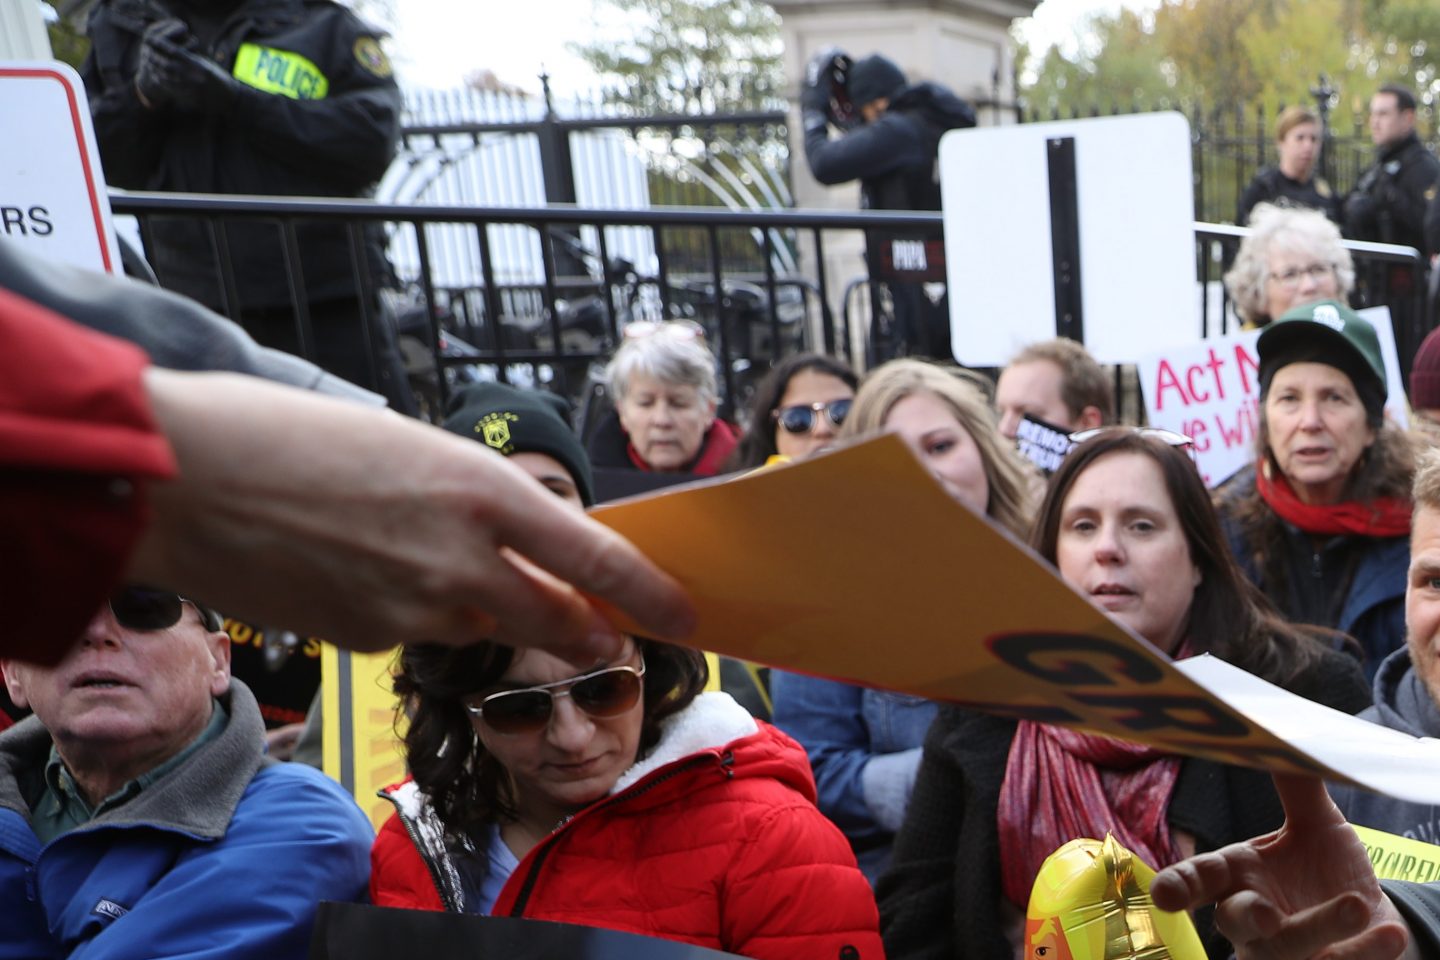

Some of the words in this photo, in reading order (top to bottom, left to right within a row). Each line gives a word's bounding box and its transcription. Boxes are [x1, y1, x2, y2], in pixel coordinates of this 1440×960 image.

[253, 49, 323, 100] POLICE
[1, 206, 53, 236] RS
[1155, 348, 1225, 412] Act
